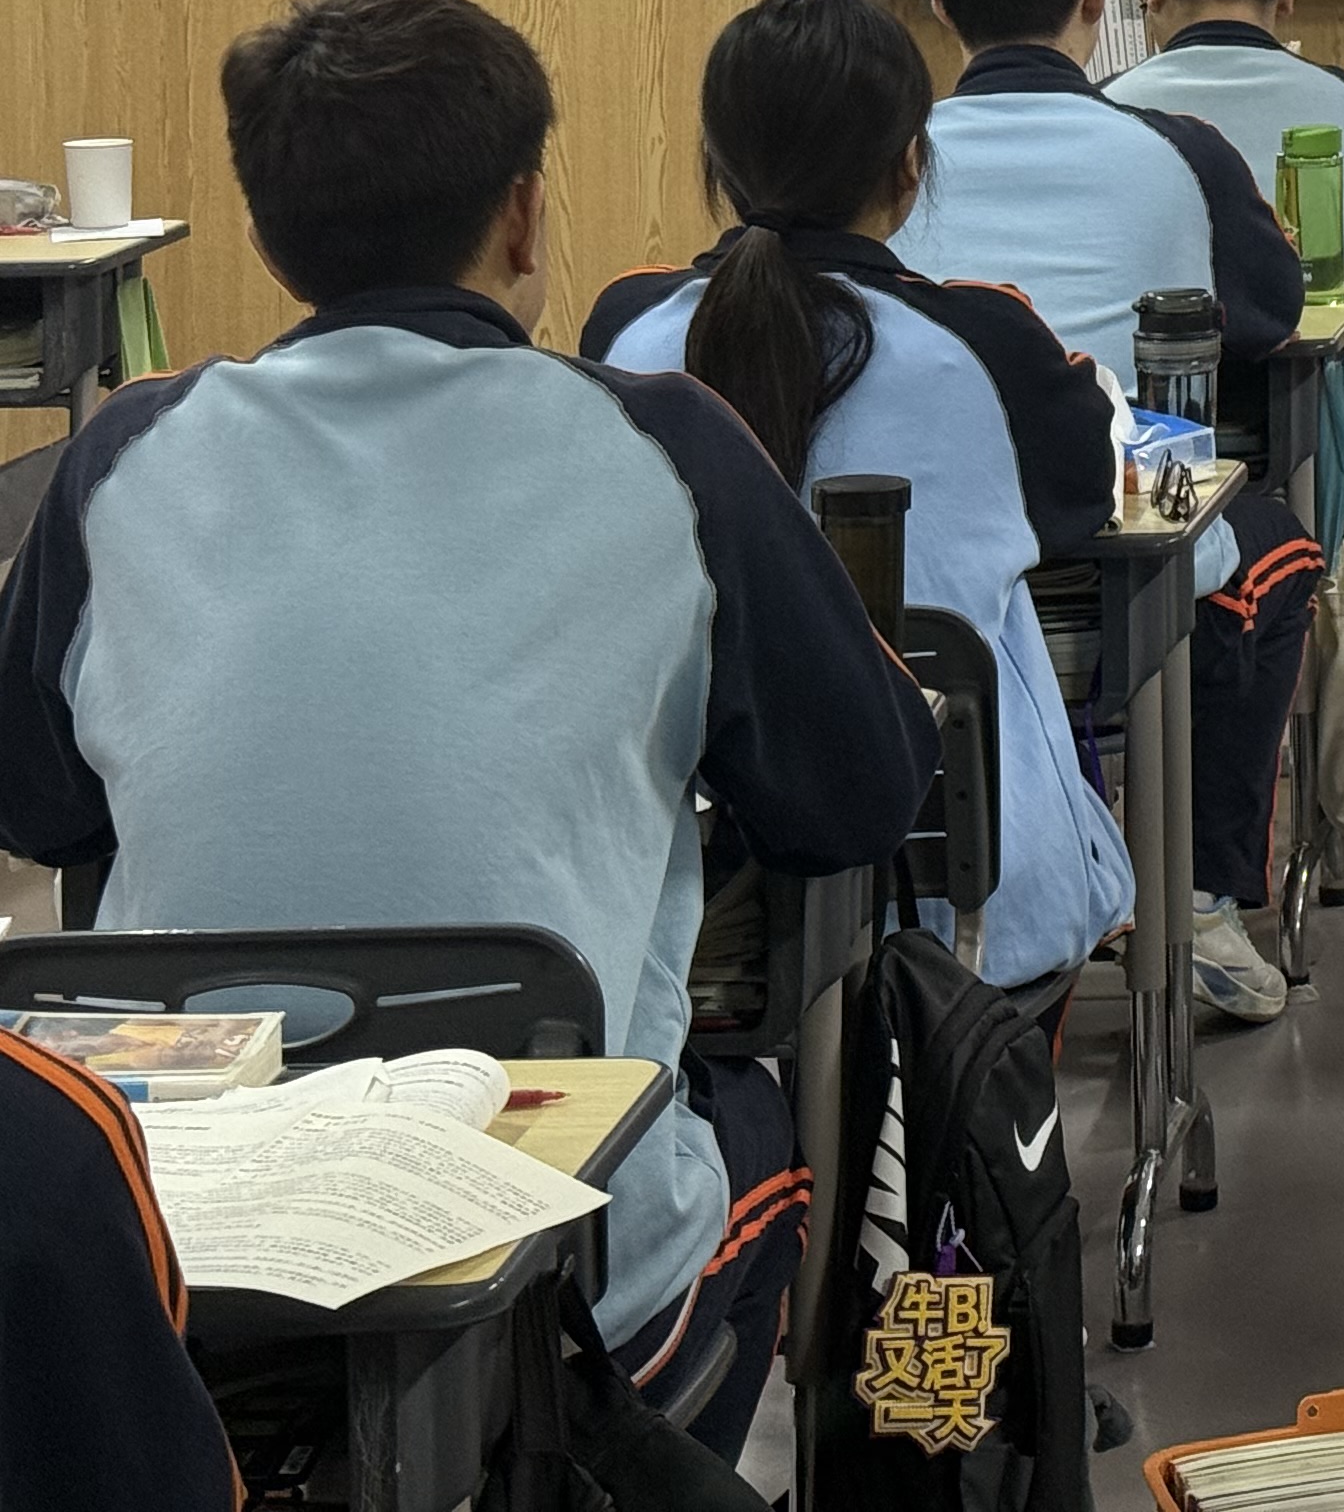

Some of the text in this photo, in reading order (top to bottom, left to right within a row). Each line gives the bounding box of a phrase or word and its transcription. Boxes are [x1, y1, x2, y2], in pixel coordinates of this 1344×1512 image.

[871, 1334, 1006, 1390] 又活了
[887, 1389, 981, 1439] 一天
